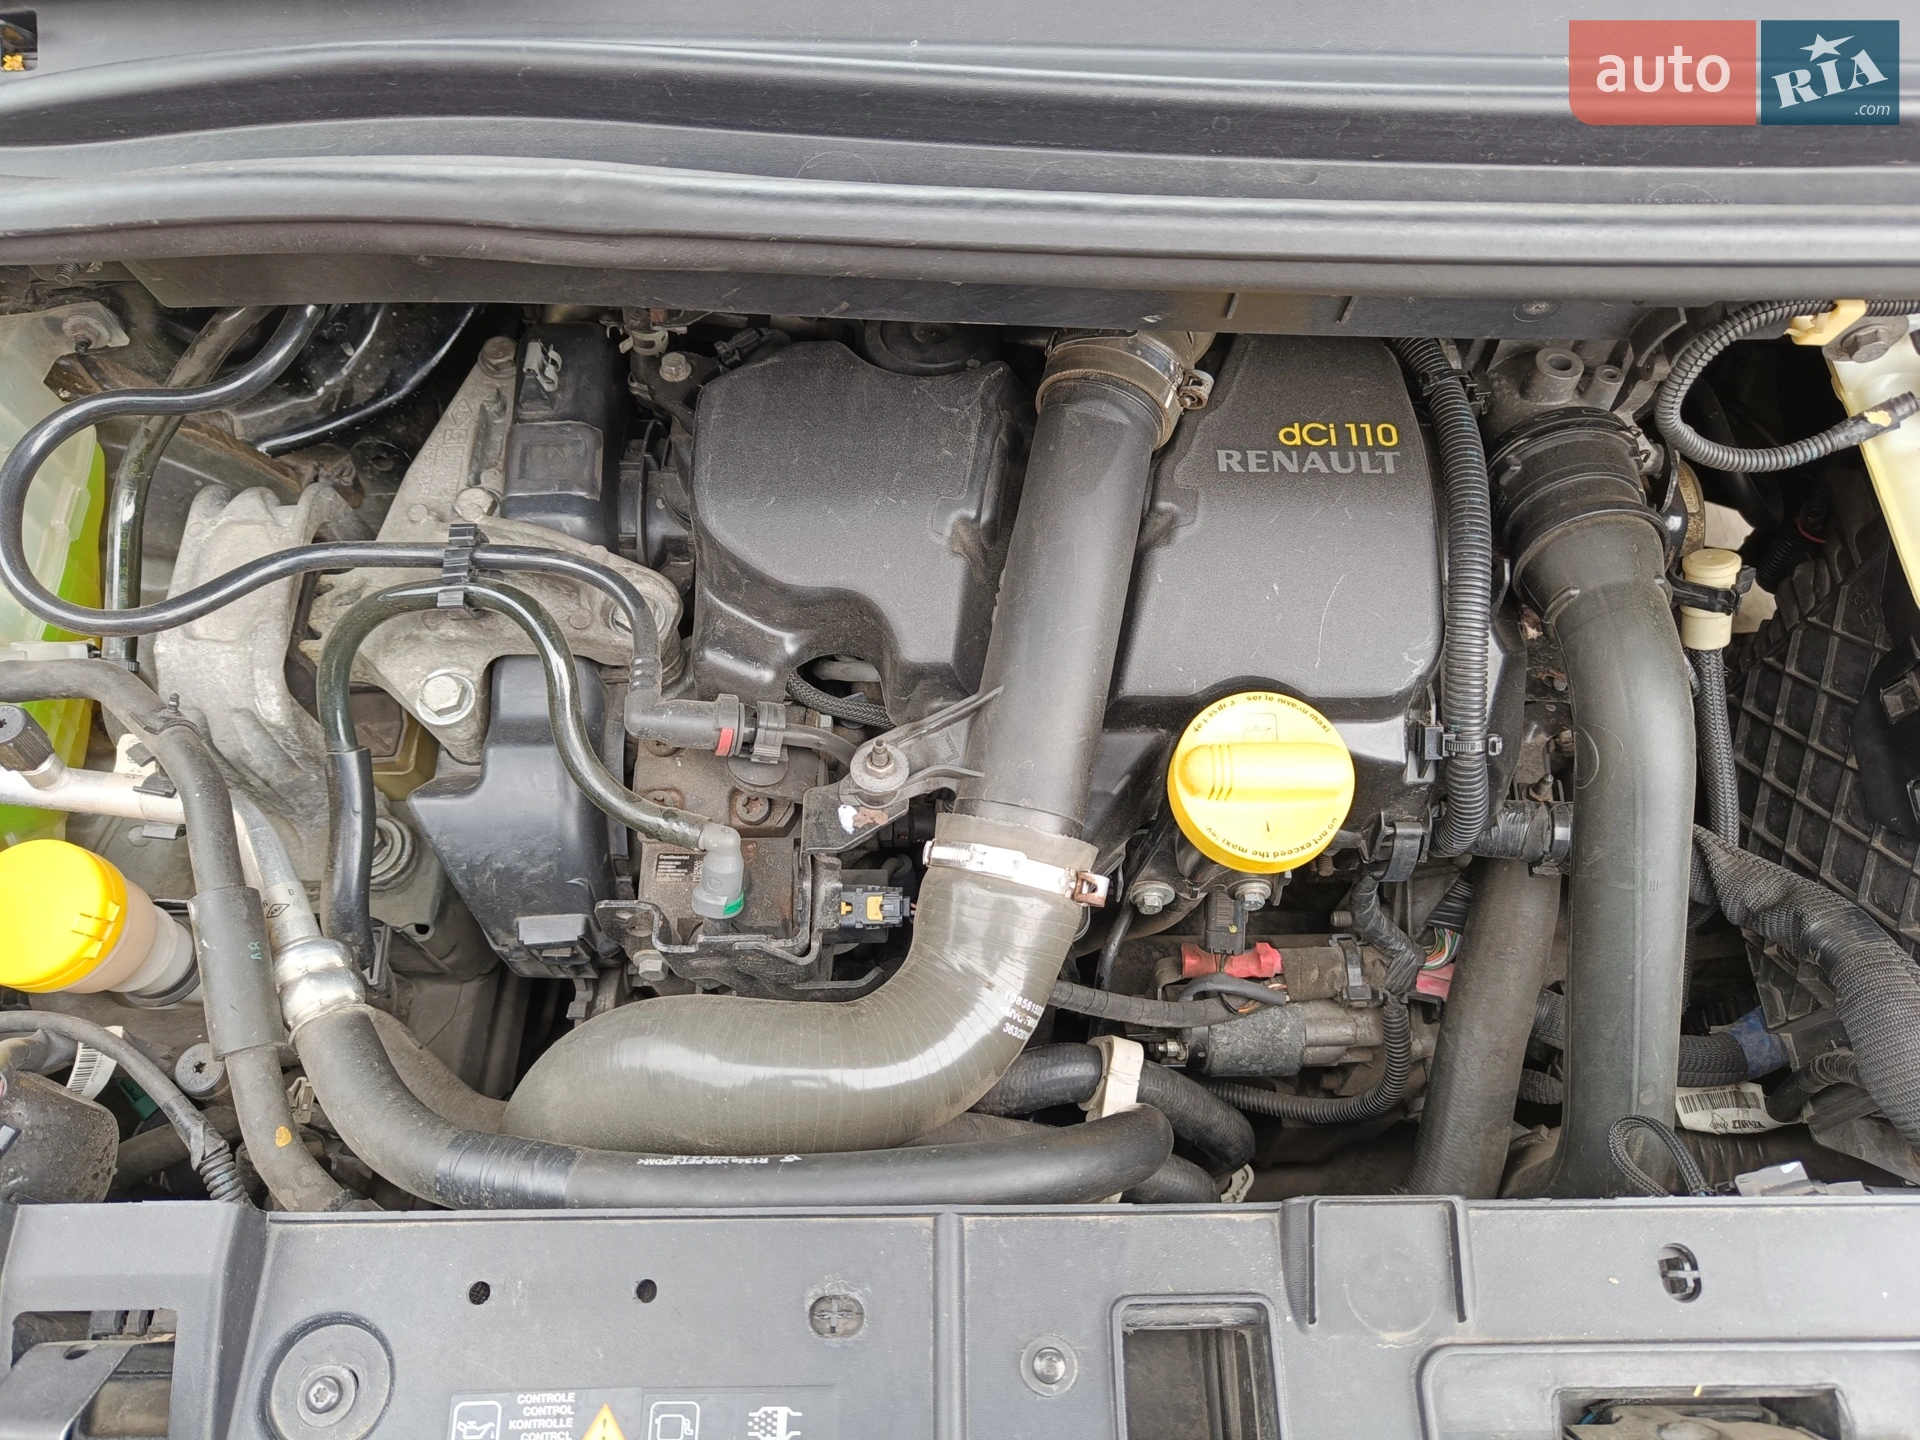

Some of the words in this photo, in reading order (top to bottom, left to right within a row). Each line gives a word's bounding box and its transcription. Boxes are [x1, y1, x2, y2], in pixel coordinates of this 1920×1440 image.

[1278, 422, 1337, 447] dCi
[1344, 423, 1399, 447] 110
[1216, 449, 1401, 474] RENAULT
[1251, 850, 1270, 858] the
[1272, 842, 1312, 859] exceed
[517, 1391, 576, 1405] CONTROLE
[522, 1404, 575, 1417] CONTROL
[508, 1417, 574, 1430] KONTROLLE
